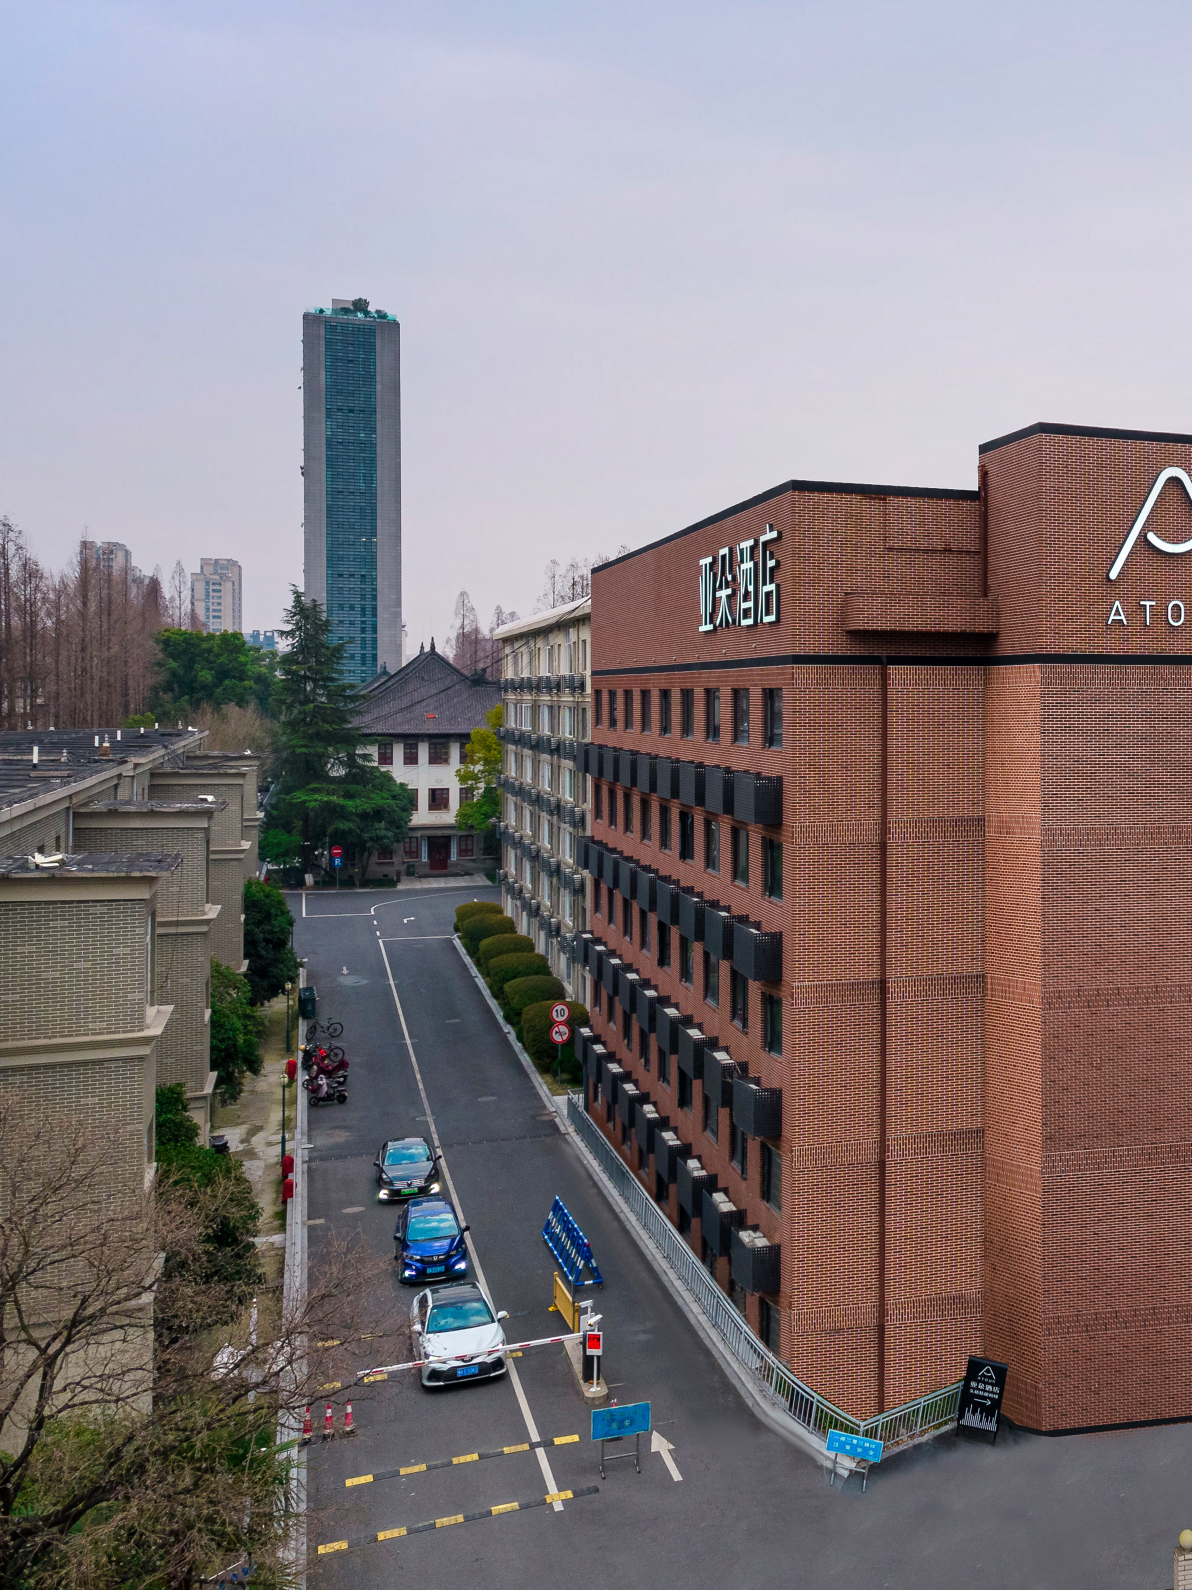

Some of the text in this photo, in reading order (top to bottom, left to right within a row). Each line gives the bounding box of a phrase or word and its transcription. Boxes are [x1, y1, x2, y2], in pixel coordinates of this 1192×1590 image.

[698, 524, 782, 633] 亚朵酒店
[555, 1007, 566, 1018] 10
